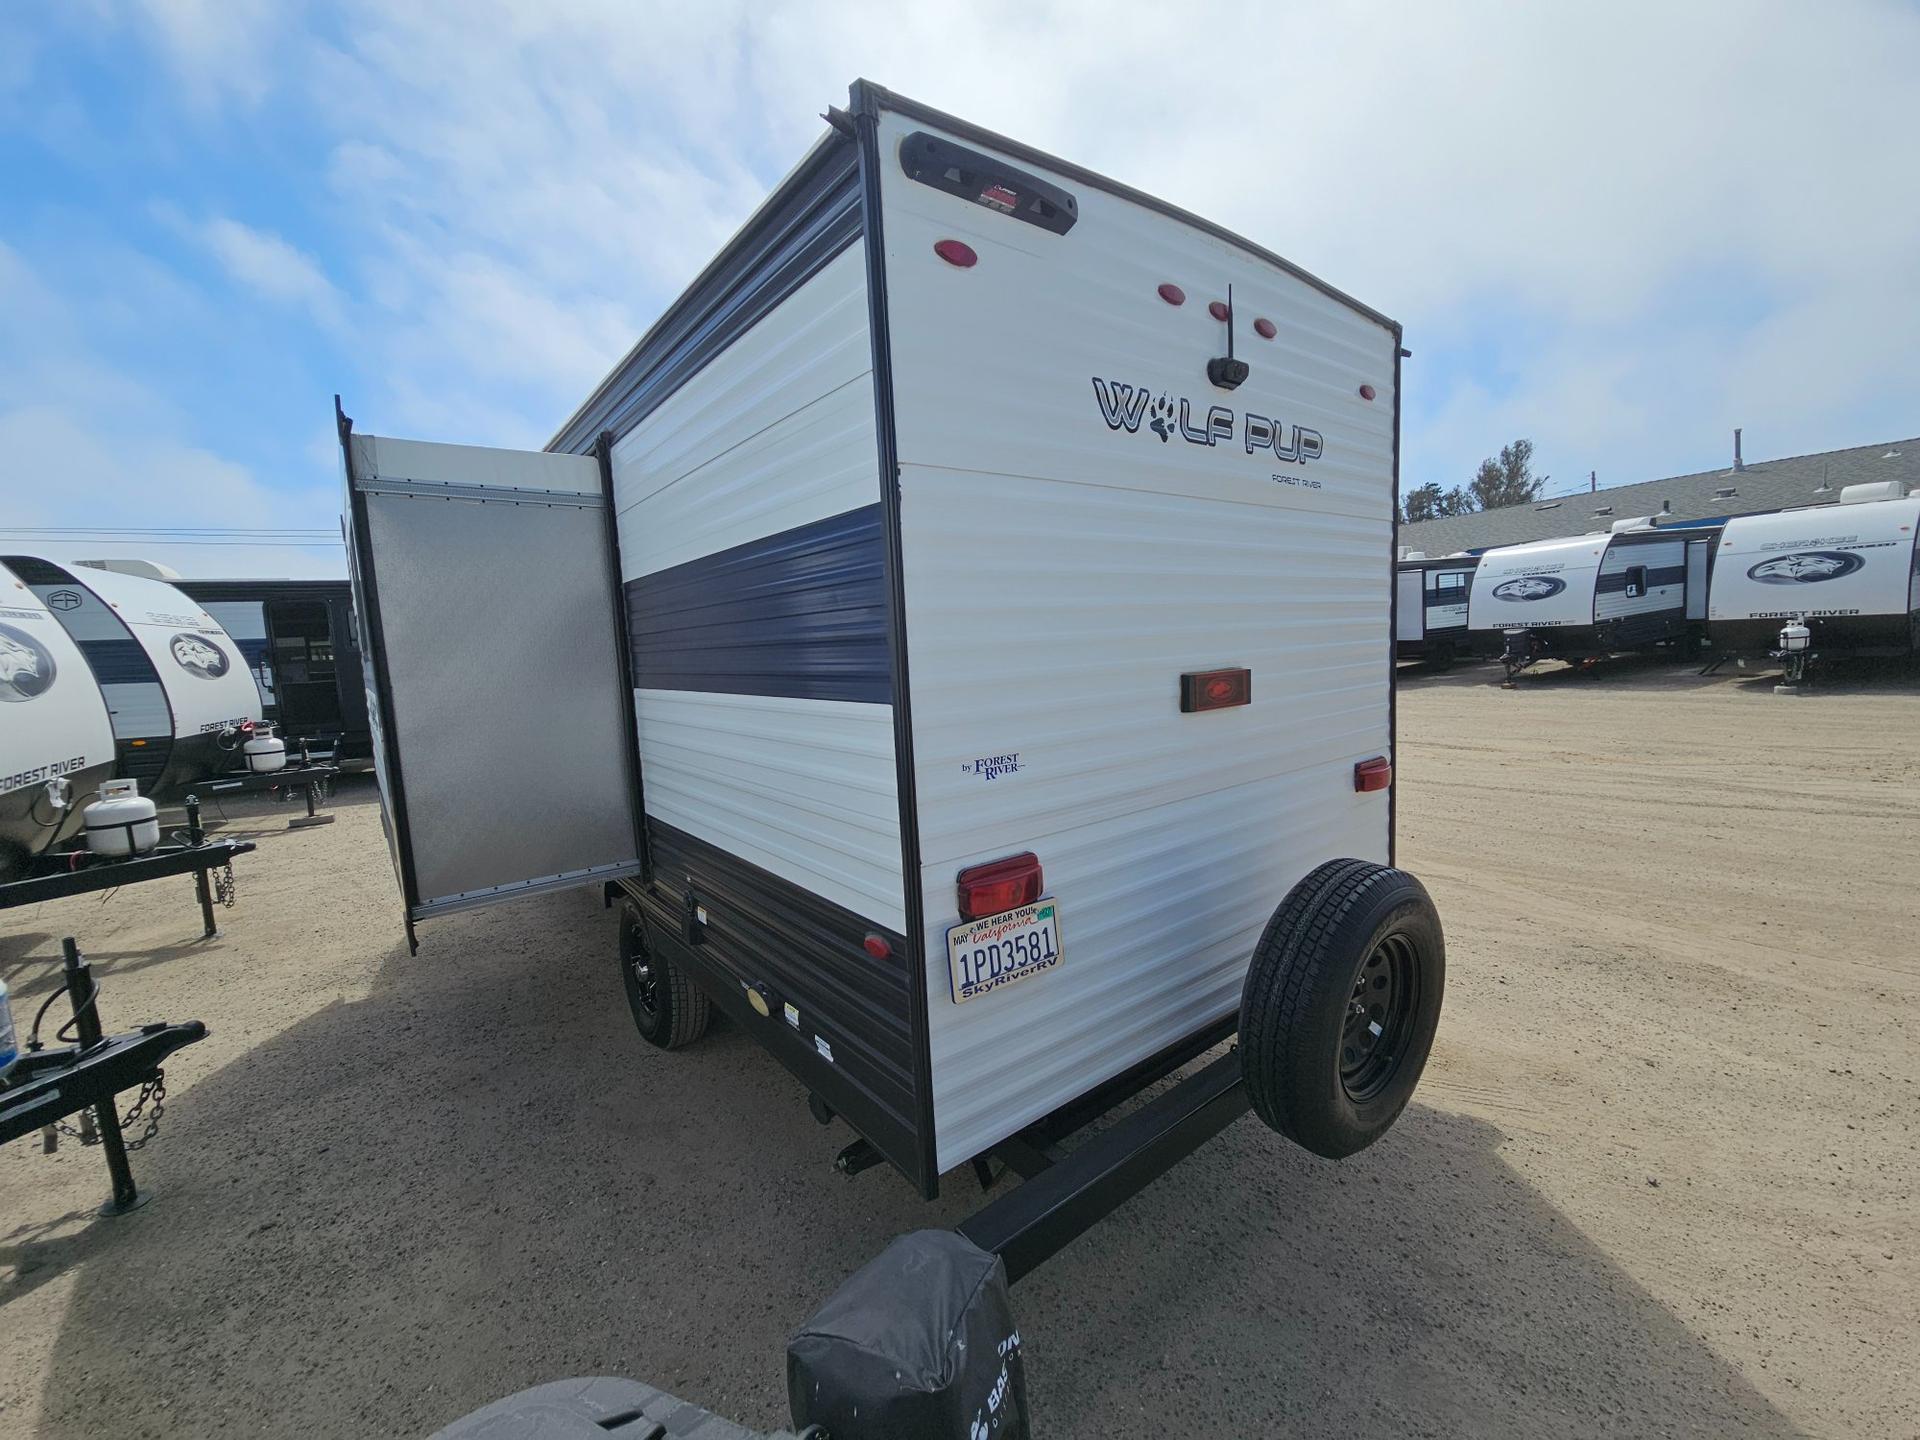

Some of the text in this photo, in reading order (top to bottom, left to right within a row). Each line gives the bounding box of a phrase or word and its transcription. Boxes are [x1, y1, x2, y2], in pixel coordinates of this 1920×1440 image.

[1245, 412, 1324, 465] PUP
[1271, 474, 1322, 489] FOREST RIVER
[1749, 608, 1860, 618] FOREST RIVER
[200, 720, 229, 732] FOREST
[50, 756, 86, 776] RIVER
[962, 753, 1018, 773] by FOREST
[985, 763, 1018, 780] RIVER
[972, 917, 1038, 944] California
[976, 920, 990, 931] WE
[991, 913, 1014, 926] HEAR
[953, 933, 969, 946] MAY
[960, 927, 1055, 990] 1PD3581
[962, 956, 1058, 998] SkyRiverRV
